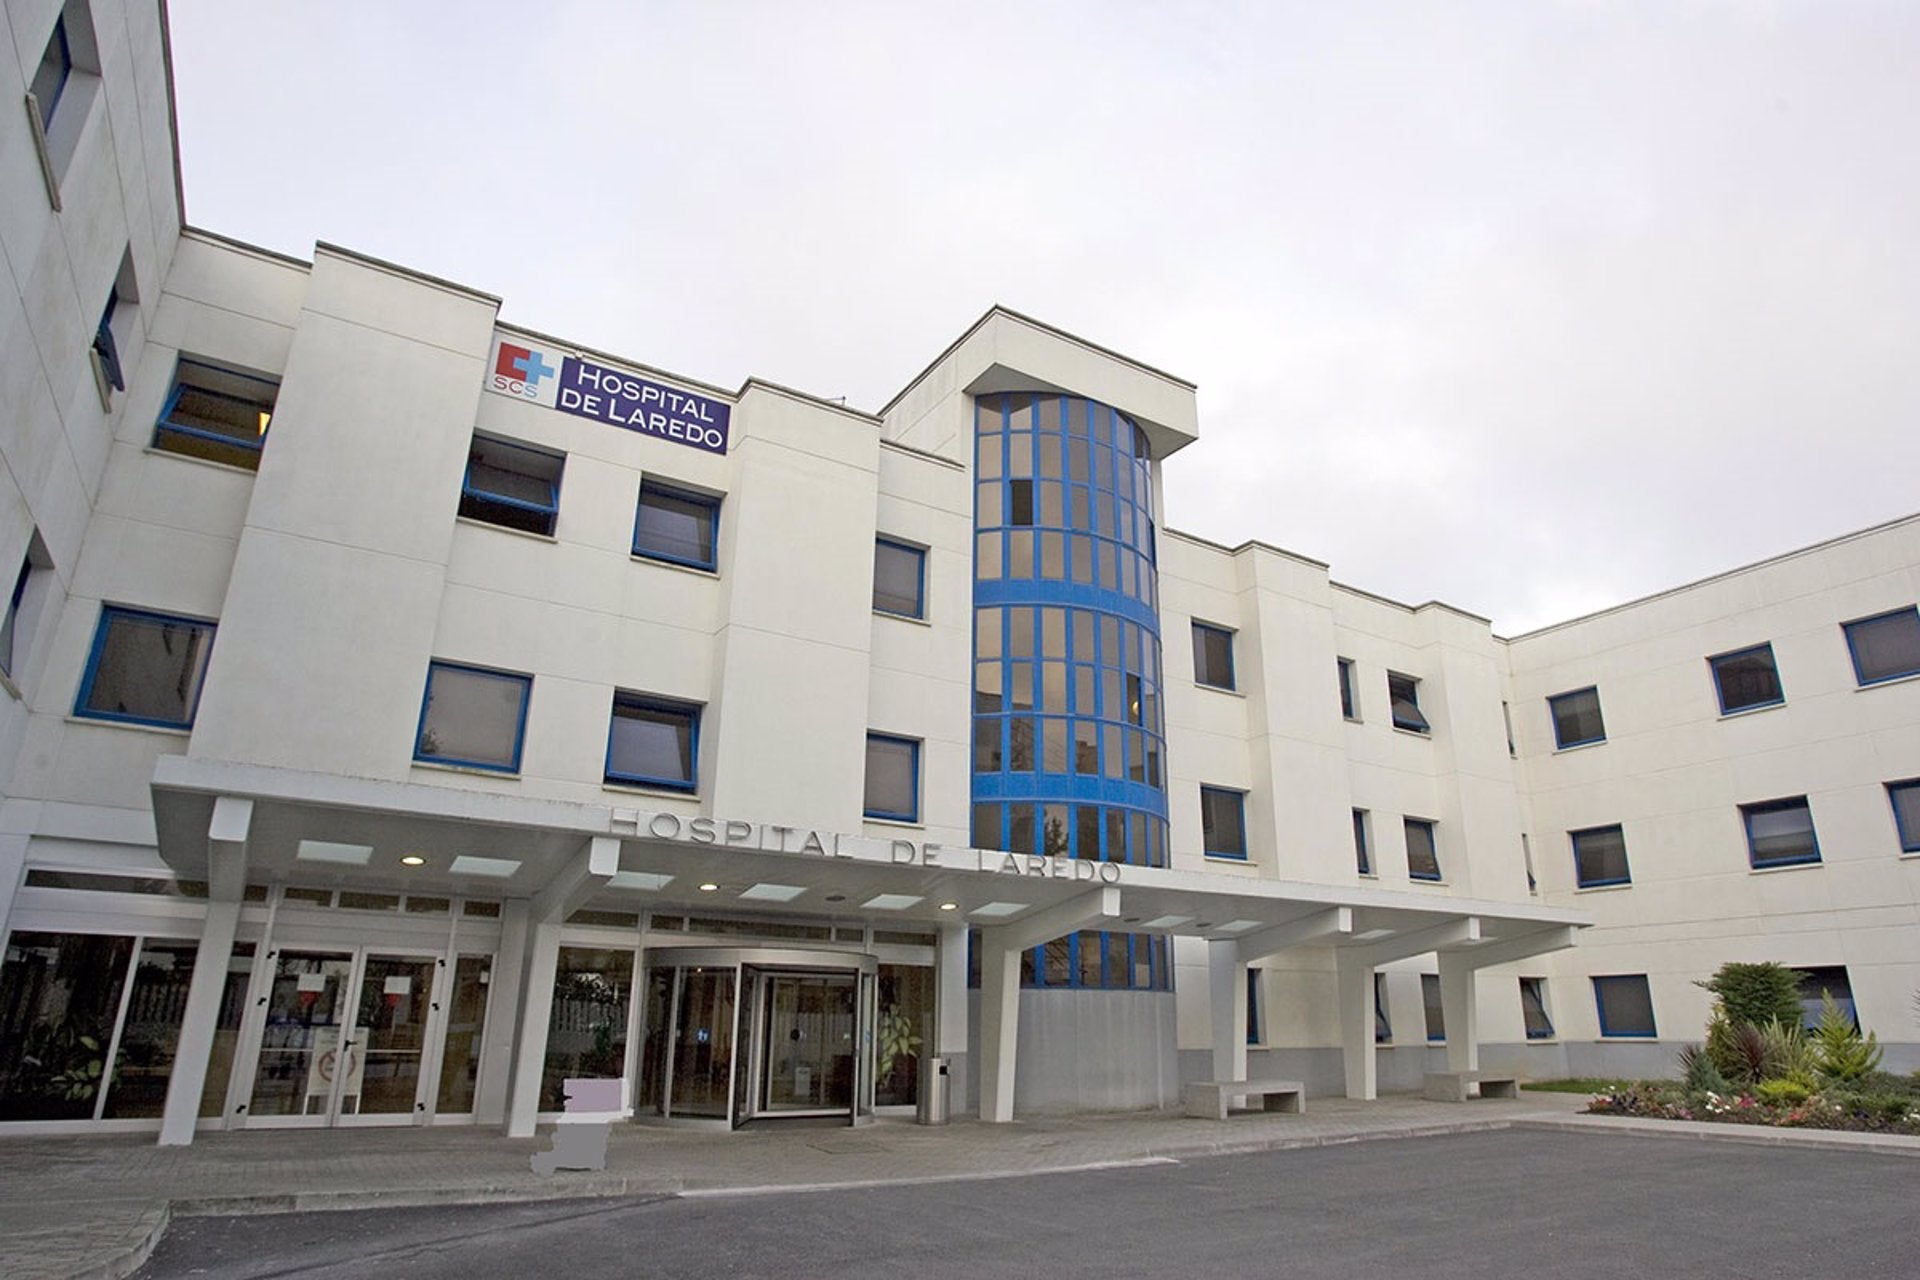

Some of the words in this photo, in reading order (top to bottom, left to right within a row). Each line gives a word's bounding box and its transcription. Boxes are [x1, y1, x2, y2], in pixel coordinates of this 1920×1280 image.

[493, 375, 537, 398] SCS
[577, 364, 714, 423] HOSPITAL
[560, 388, 601, 416] DE
[608, 399, 723, 448] LAREDO
[609, 807, 855, 860] HOSPITAL
[891, 839, 943, 868] DE
[978, 849, 1121, 884] LAREDO
